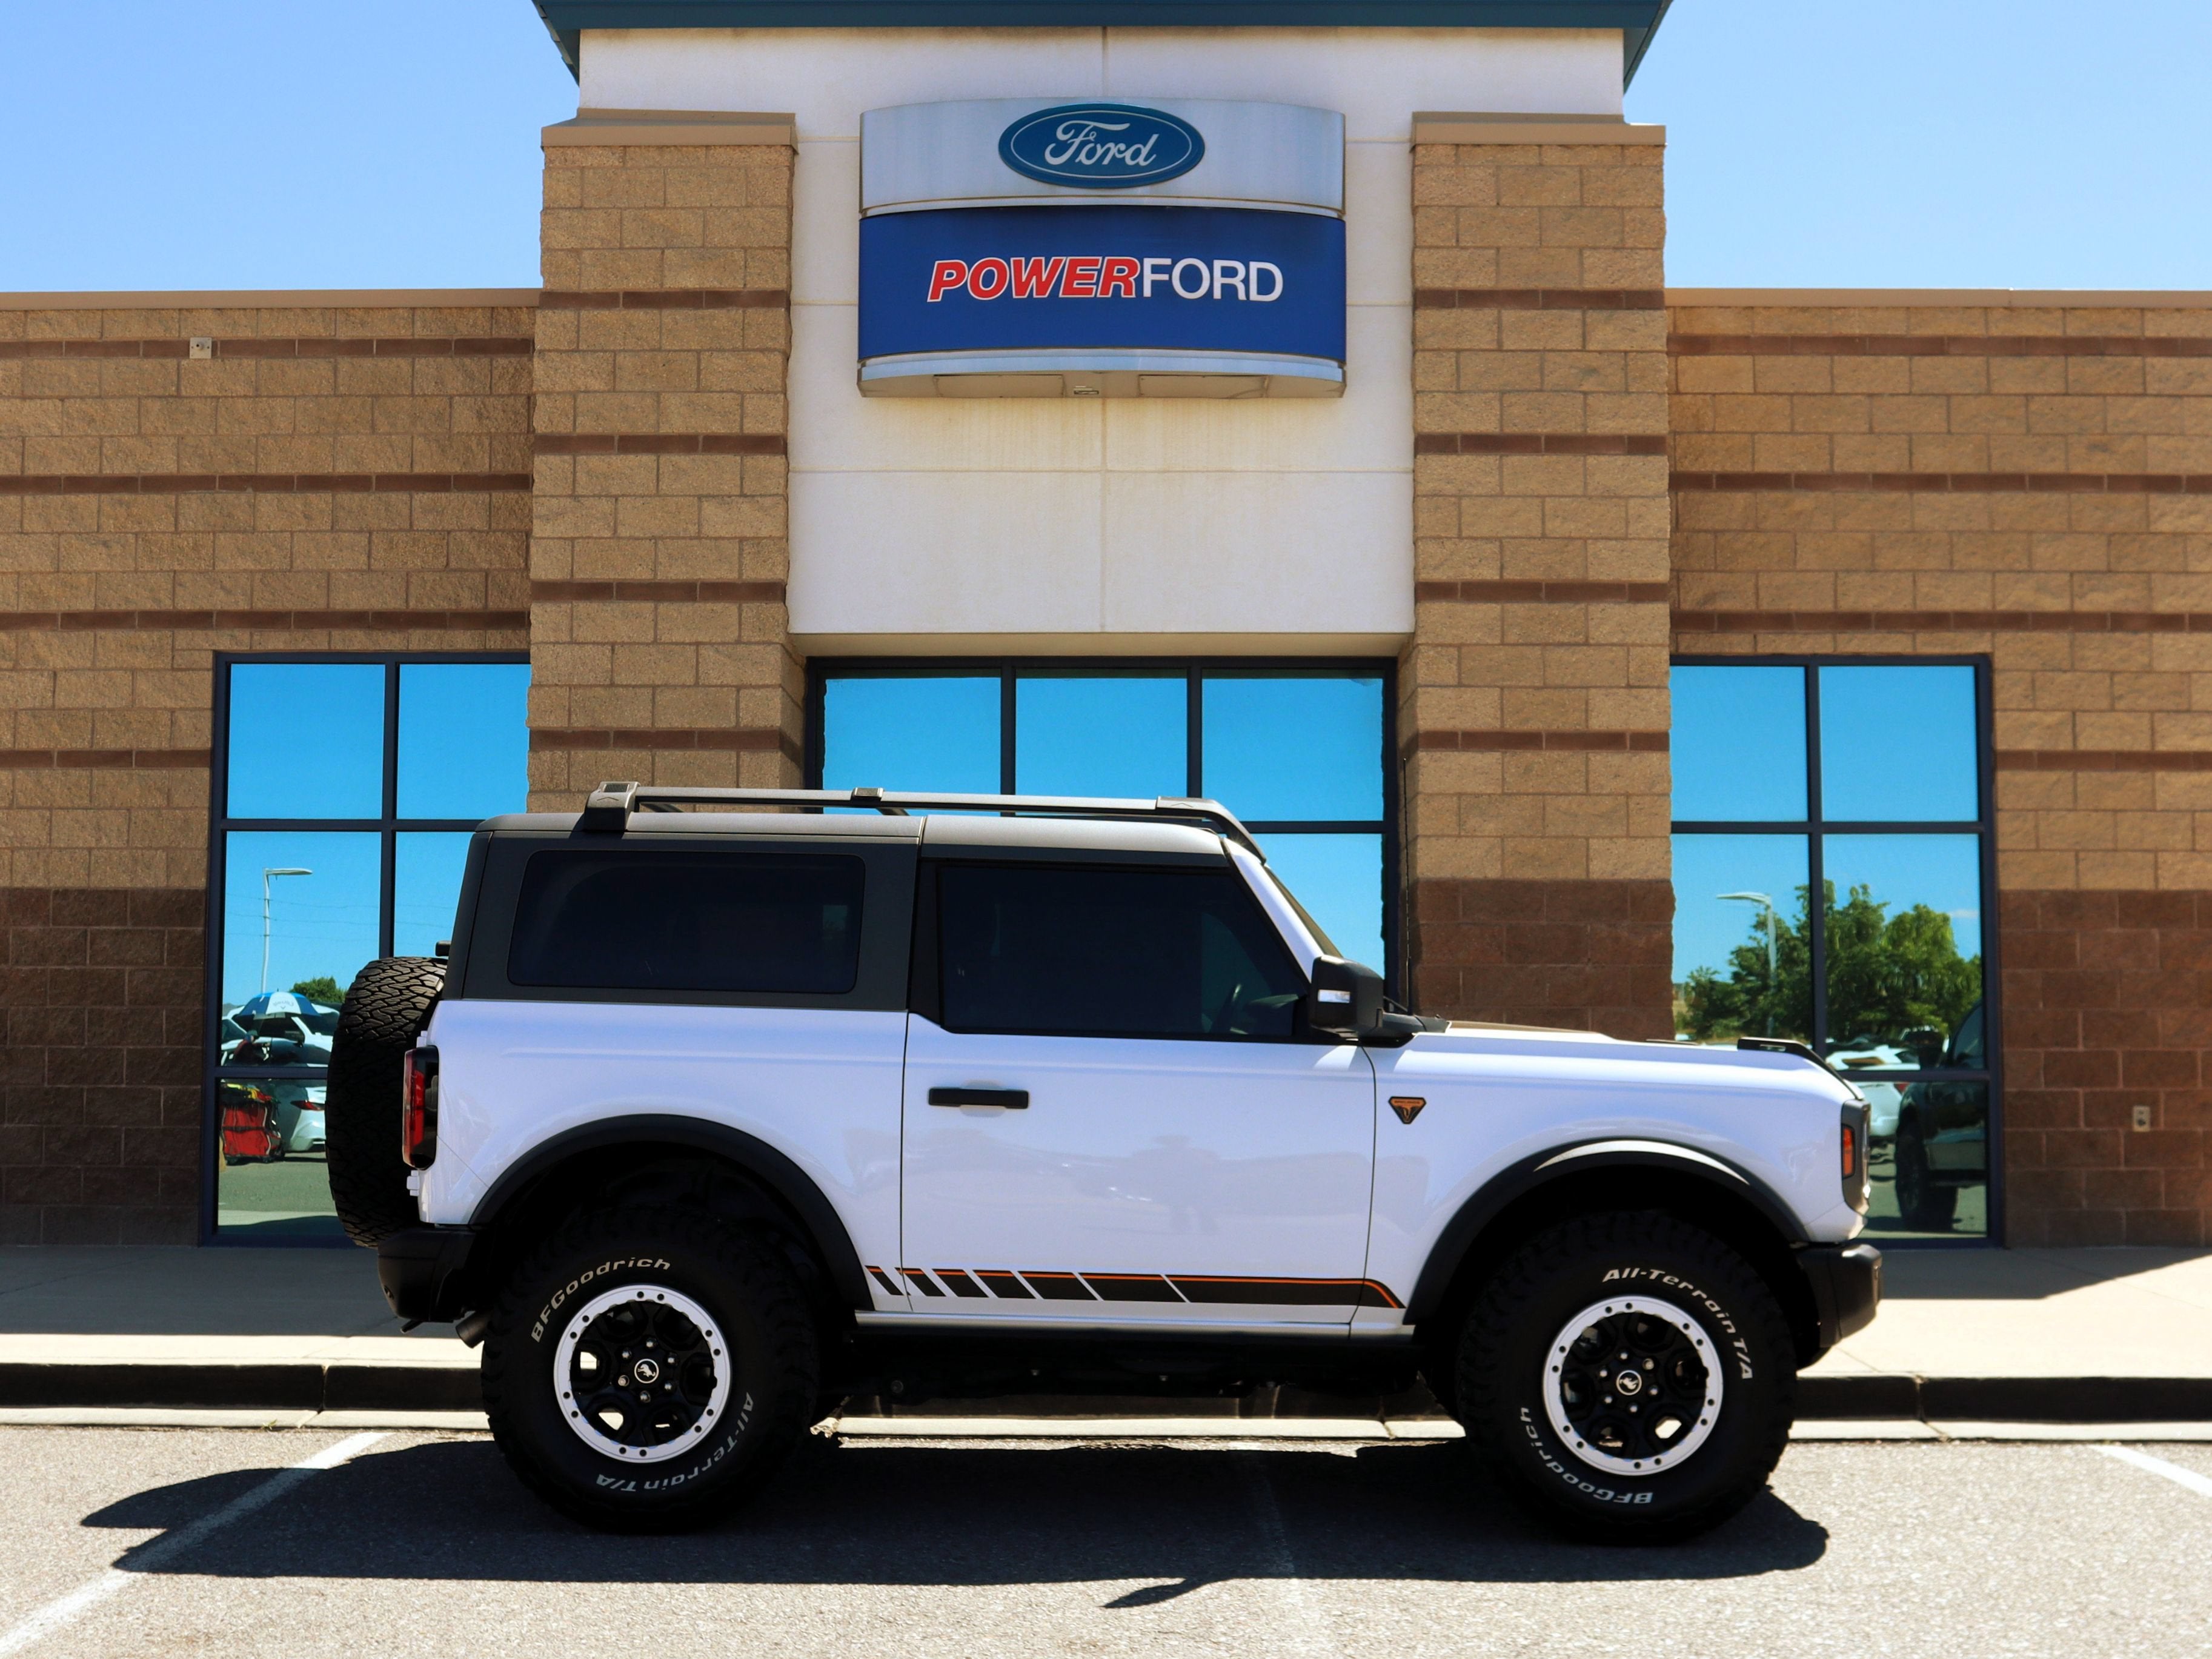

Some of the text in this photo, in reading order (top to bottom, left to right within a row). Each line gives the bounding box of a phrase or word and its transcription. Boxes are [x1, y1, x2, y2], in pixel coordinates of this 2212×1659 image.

[1045, 119, 1160, 166] Ford
[531, 1257, 671, 1343] BFGoodrich
[1602, 1267, 1753, 1380] All-Terrain T/A
[596, 1392, 754, 1492] All-Terrain T/A
[1520, 1407, 1653, 1504] BFGoodrich
